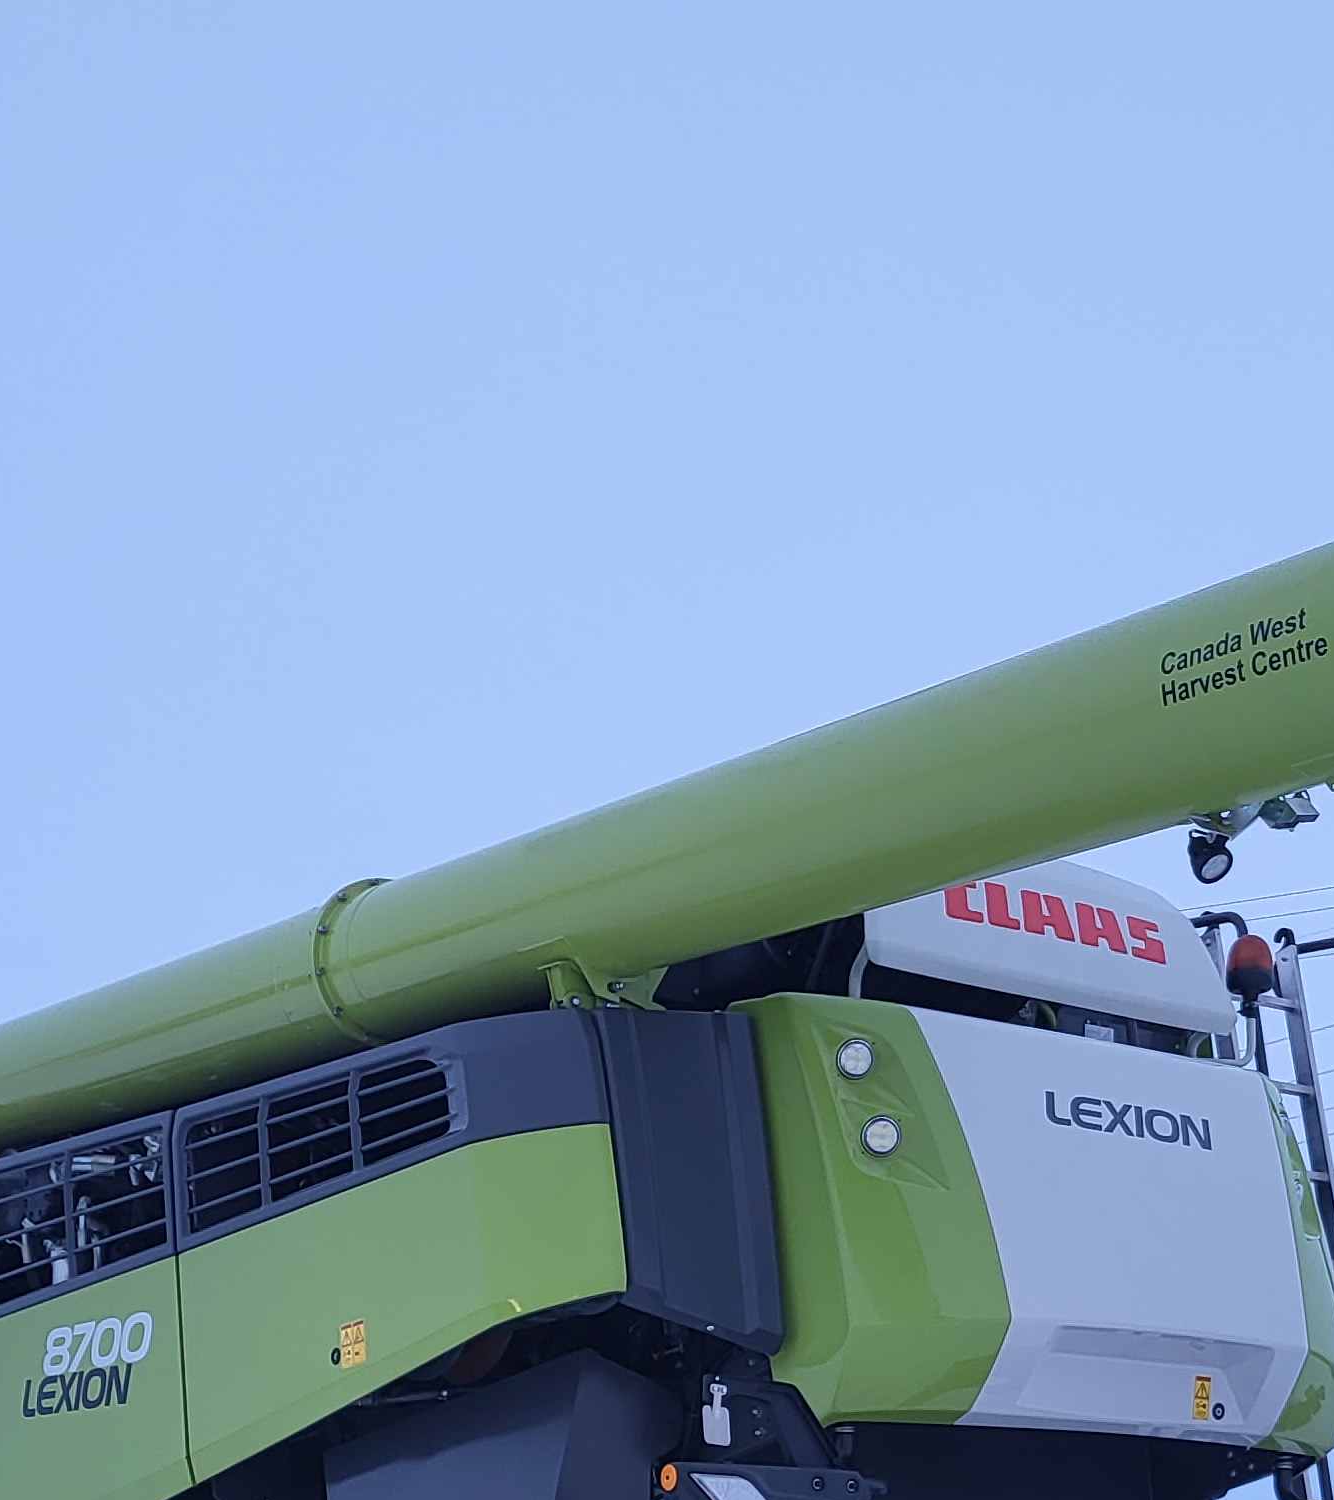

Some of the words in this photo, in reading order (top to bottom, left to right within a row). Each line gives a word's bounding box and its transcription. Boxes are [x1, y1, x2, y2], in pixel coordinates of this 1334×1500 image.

[1160, 631, 1243, 675] Canada
[1249, 607, 1307, 646] West
[1161, 658, 1247, 707] Harvest
[1251, 636, 1329, 677] Centre
[943, 881, 1167, 966] CLAAS
[1044, 1090, 1213, 1151] LEXION
[43, 1311, 153, 1376] 8700
[22, 1362, 133, 1418] LEXION
